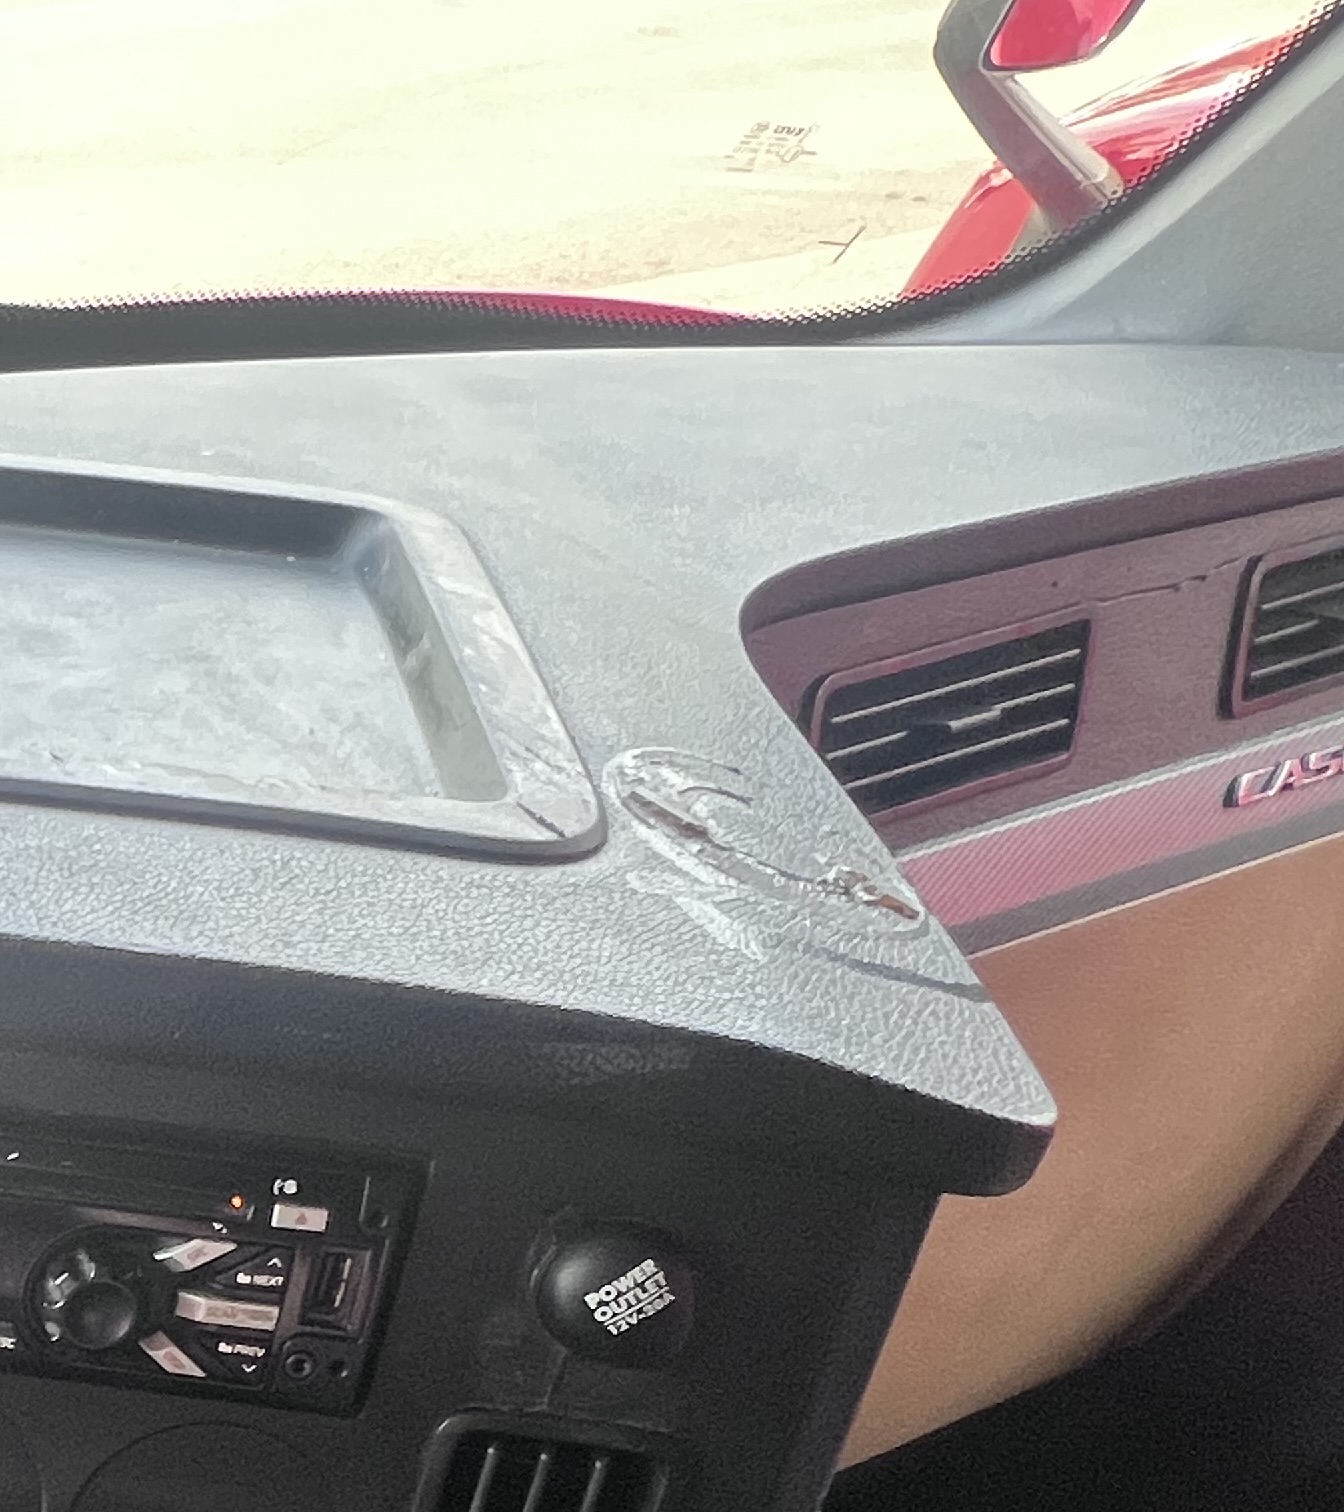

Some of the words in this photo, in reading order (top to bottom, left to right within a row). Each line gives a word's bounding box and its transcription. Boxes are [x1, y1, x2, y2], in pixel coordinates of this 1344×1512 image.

[1223, 746, 1344, 808] CAS
[583, 1258, 658, 1310] POWER
[593, 1270, 668, 1322] OUTLET
